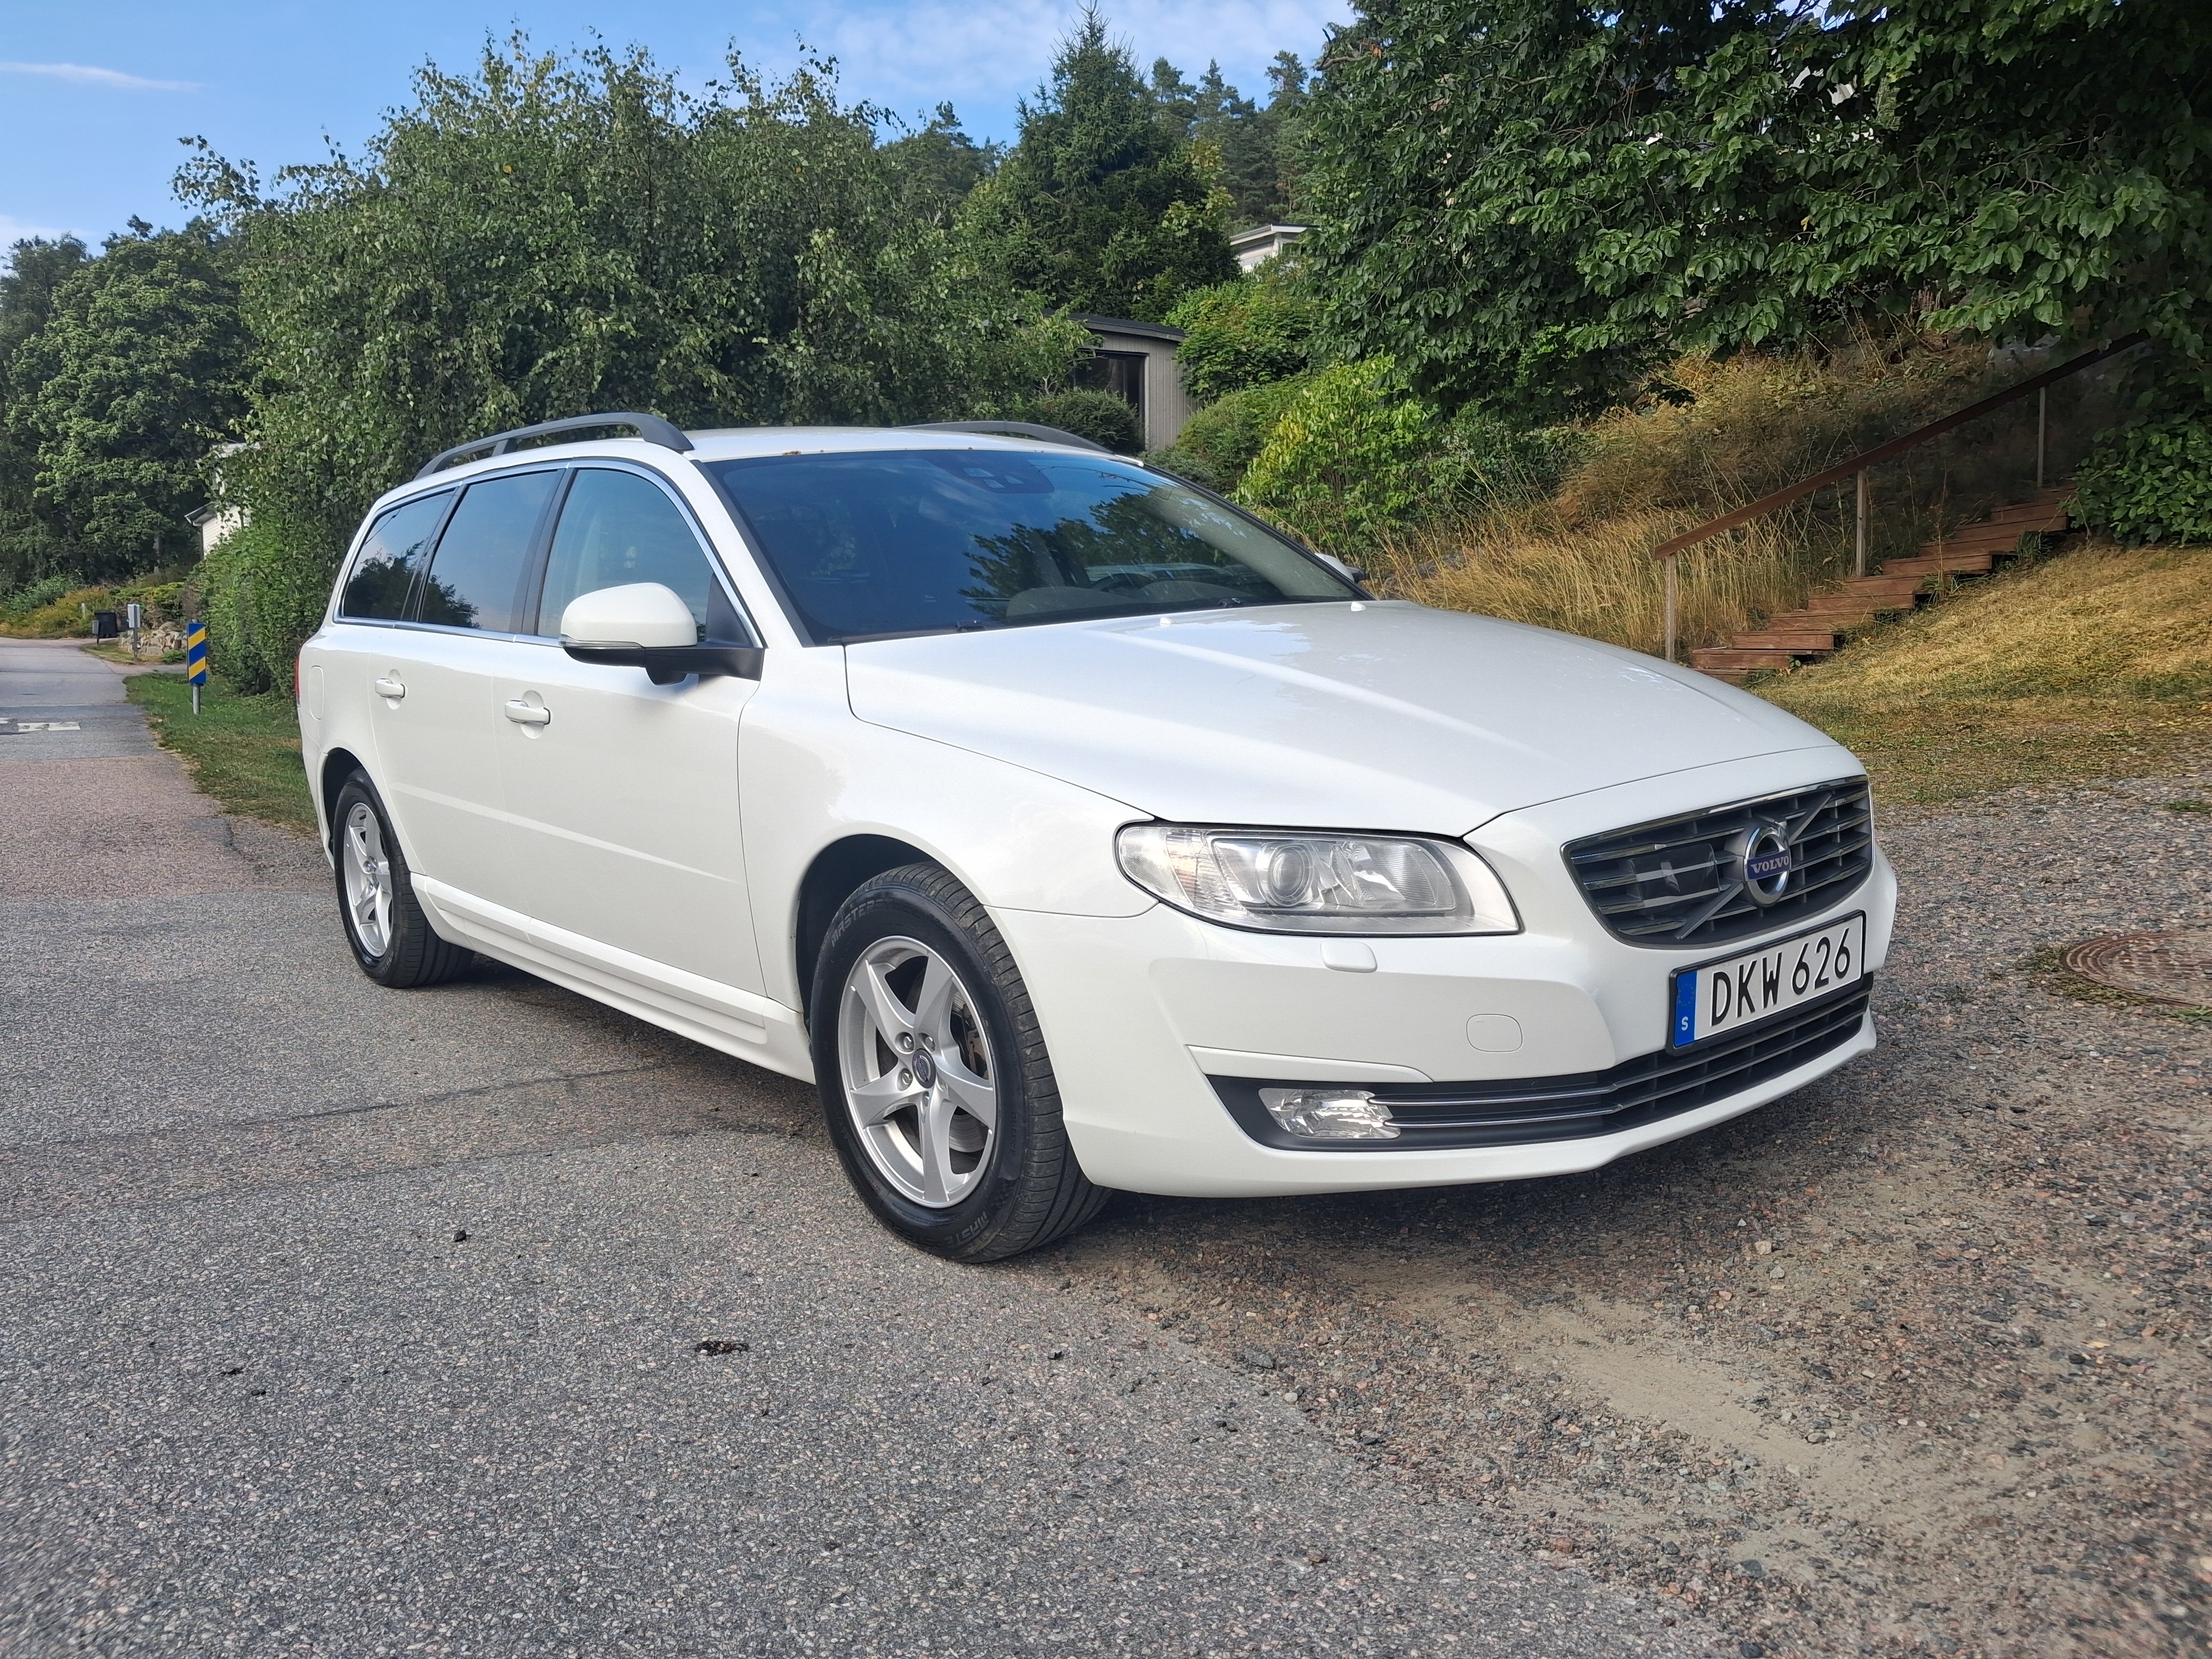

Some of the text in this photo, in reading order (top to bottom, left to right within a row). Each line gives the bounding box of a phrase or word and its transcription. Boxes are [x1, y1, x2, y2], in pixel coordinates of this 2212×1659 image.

[1751, 855, 1789, 874] VOLVO
[1711, 928, 1851, 1027] DKW 626
[1681, 1016, 1689, 1031] S
